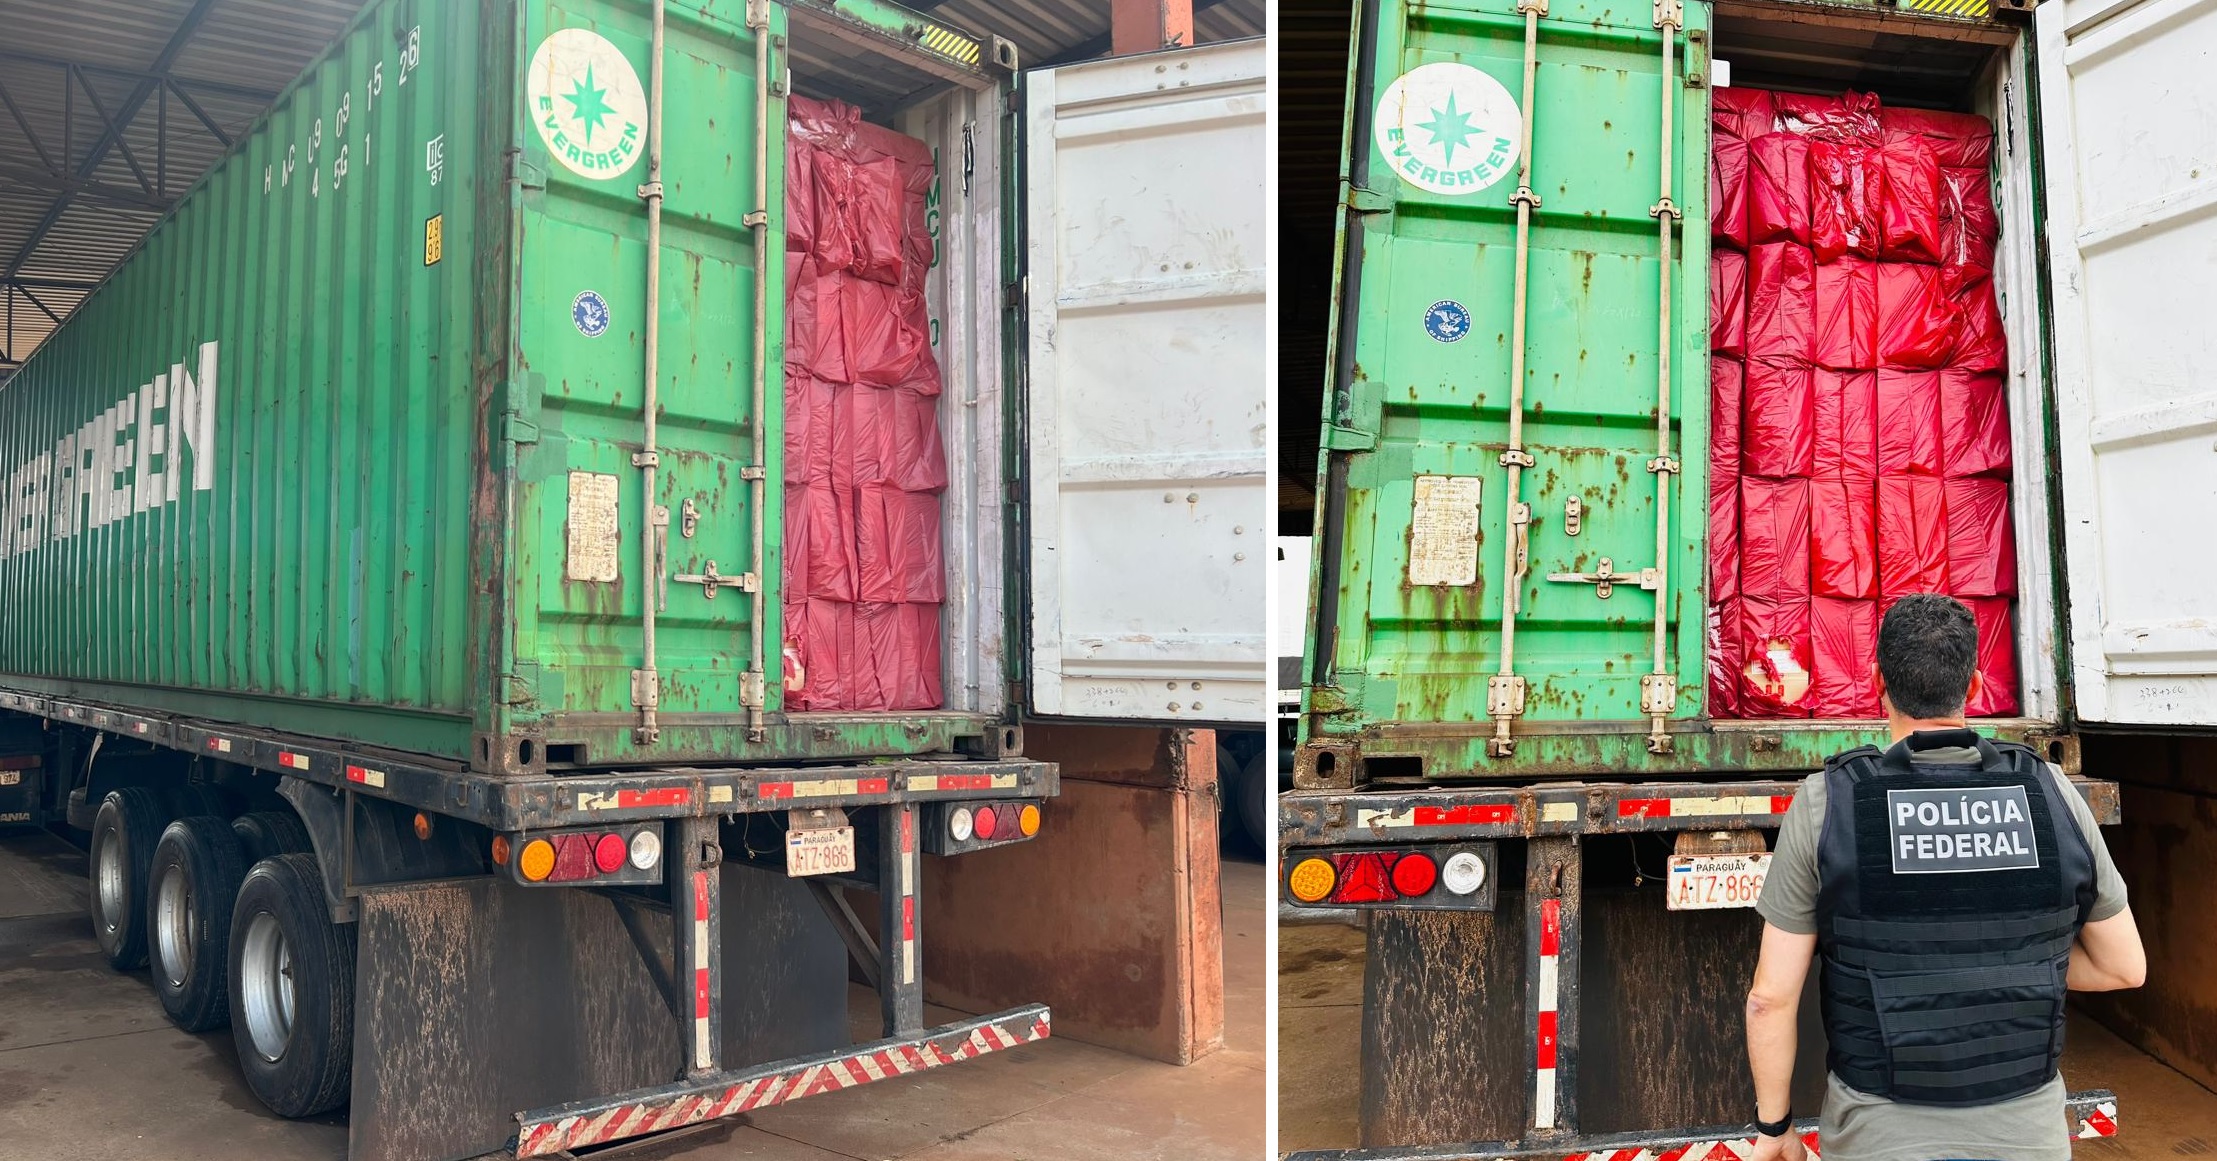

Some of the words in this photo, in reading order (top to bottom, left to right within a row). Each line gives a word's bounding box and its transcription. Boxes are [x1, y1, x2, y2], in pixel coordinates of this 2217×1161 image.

[539, 95, 639, 169] EVERGREEN
[1387, 127, 1511, 186] EVERGREEN
[1426, 301, 1451, 321] AMERICAN
[1453, 302, 1470, 324] BUREAU
[1437, 330, 1466, 342] SHIPPING
[1896, 795, 2025, 827] POLÍCIA
[804, 836, 836, 845] PARAGUAY
[1899, 831, 2030, 859] FEDERAL
[1696, 862, 1747, 872] PARAGUAY
